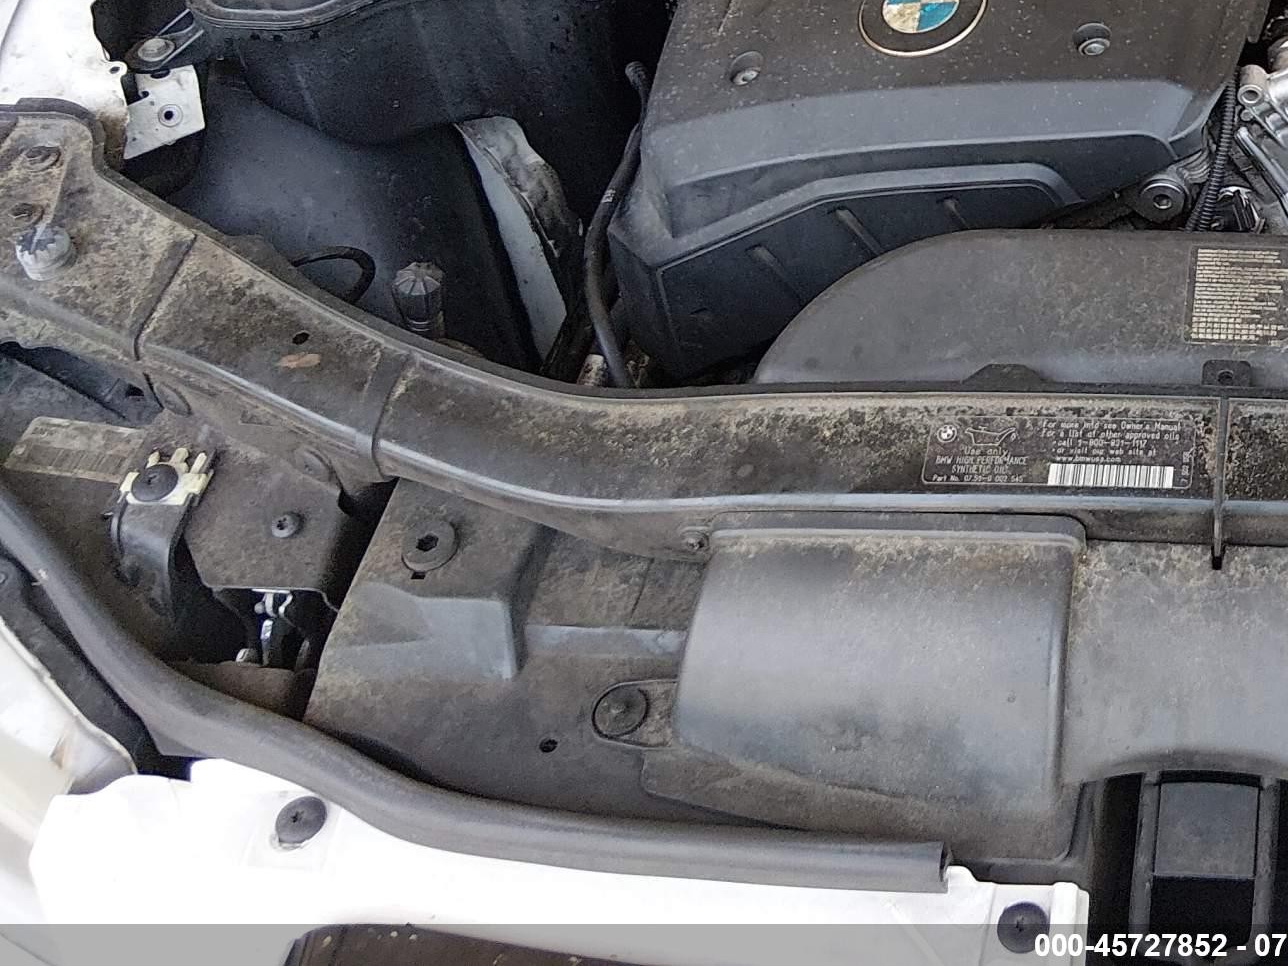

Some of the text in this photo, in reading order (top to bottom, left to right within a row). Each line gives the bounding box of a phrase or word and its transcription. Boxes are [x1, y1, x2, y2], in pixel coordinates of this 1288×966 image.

[1042, 420, 1057, 429] For
[1154, 420, 1182, 432] Manual
[1040, 429, 1056, 438] For
[1125, 431, 1161, 442] approved
[935, 455, 1028, 466] BMW HIGH PERFORMANCE
[951, 464, 992, 474] SYNTHETIC
[932, 473, 948, 482] Part
